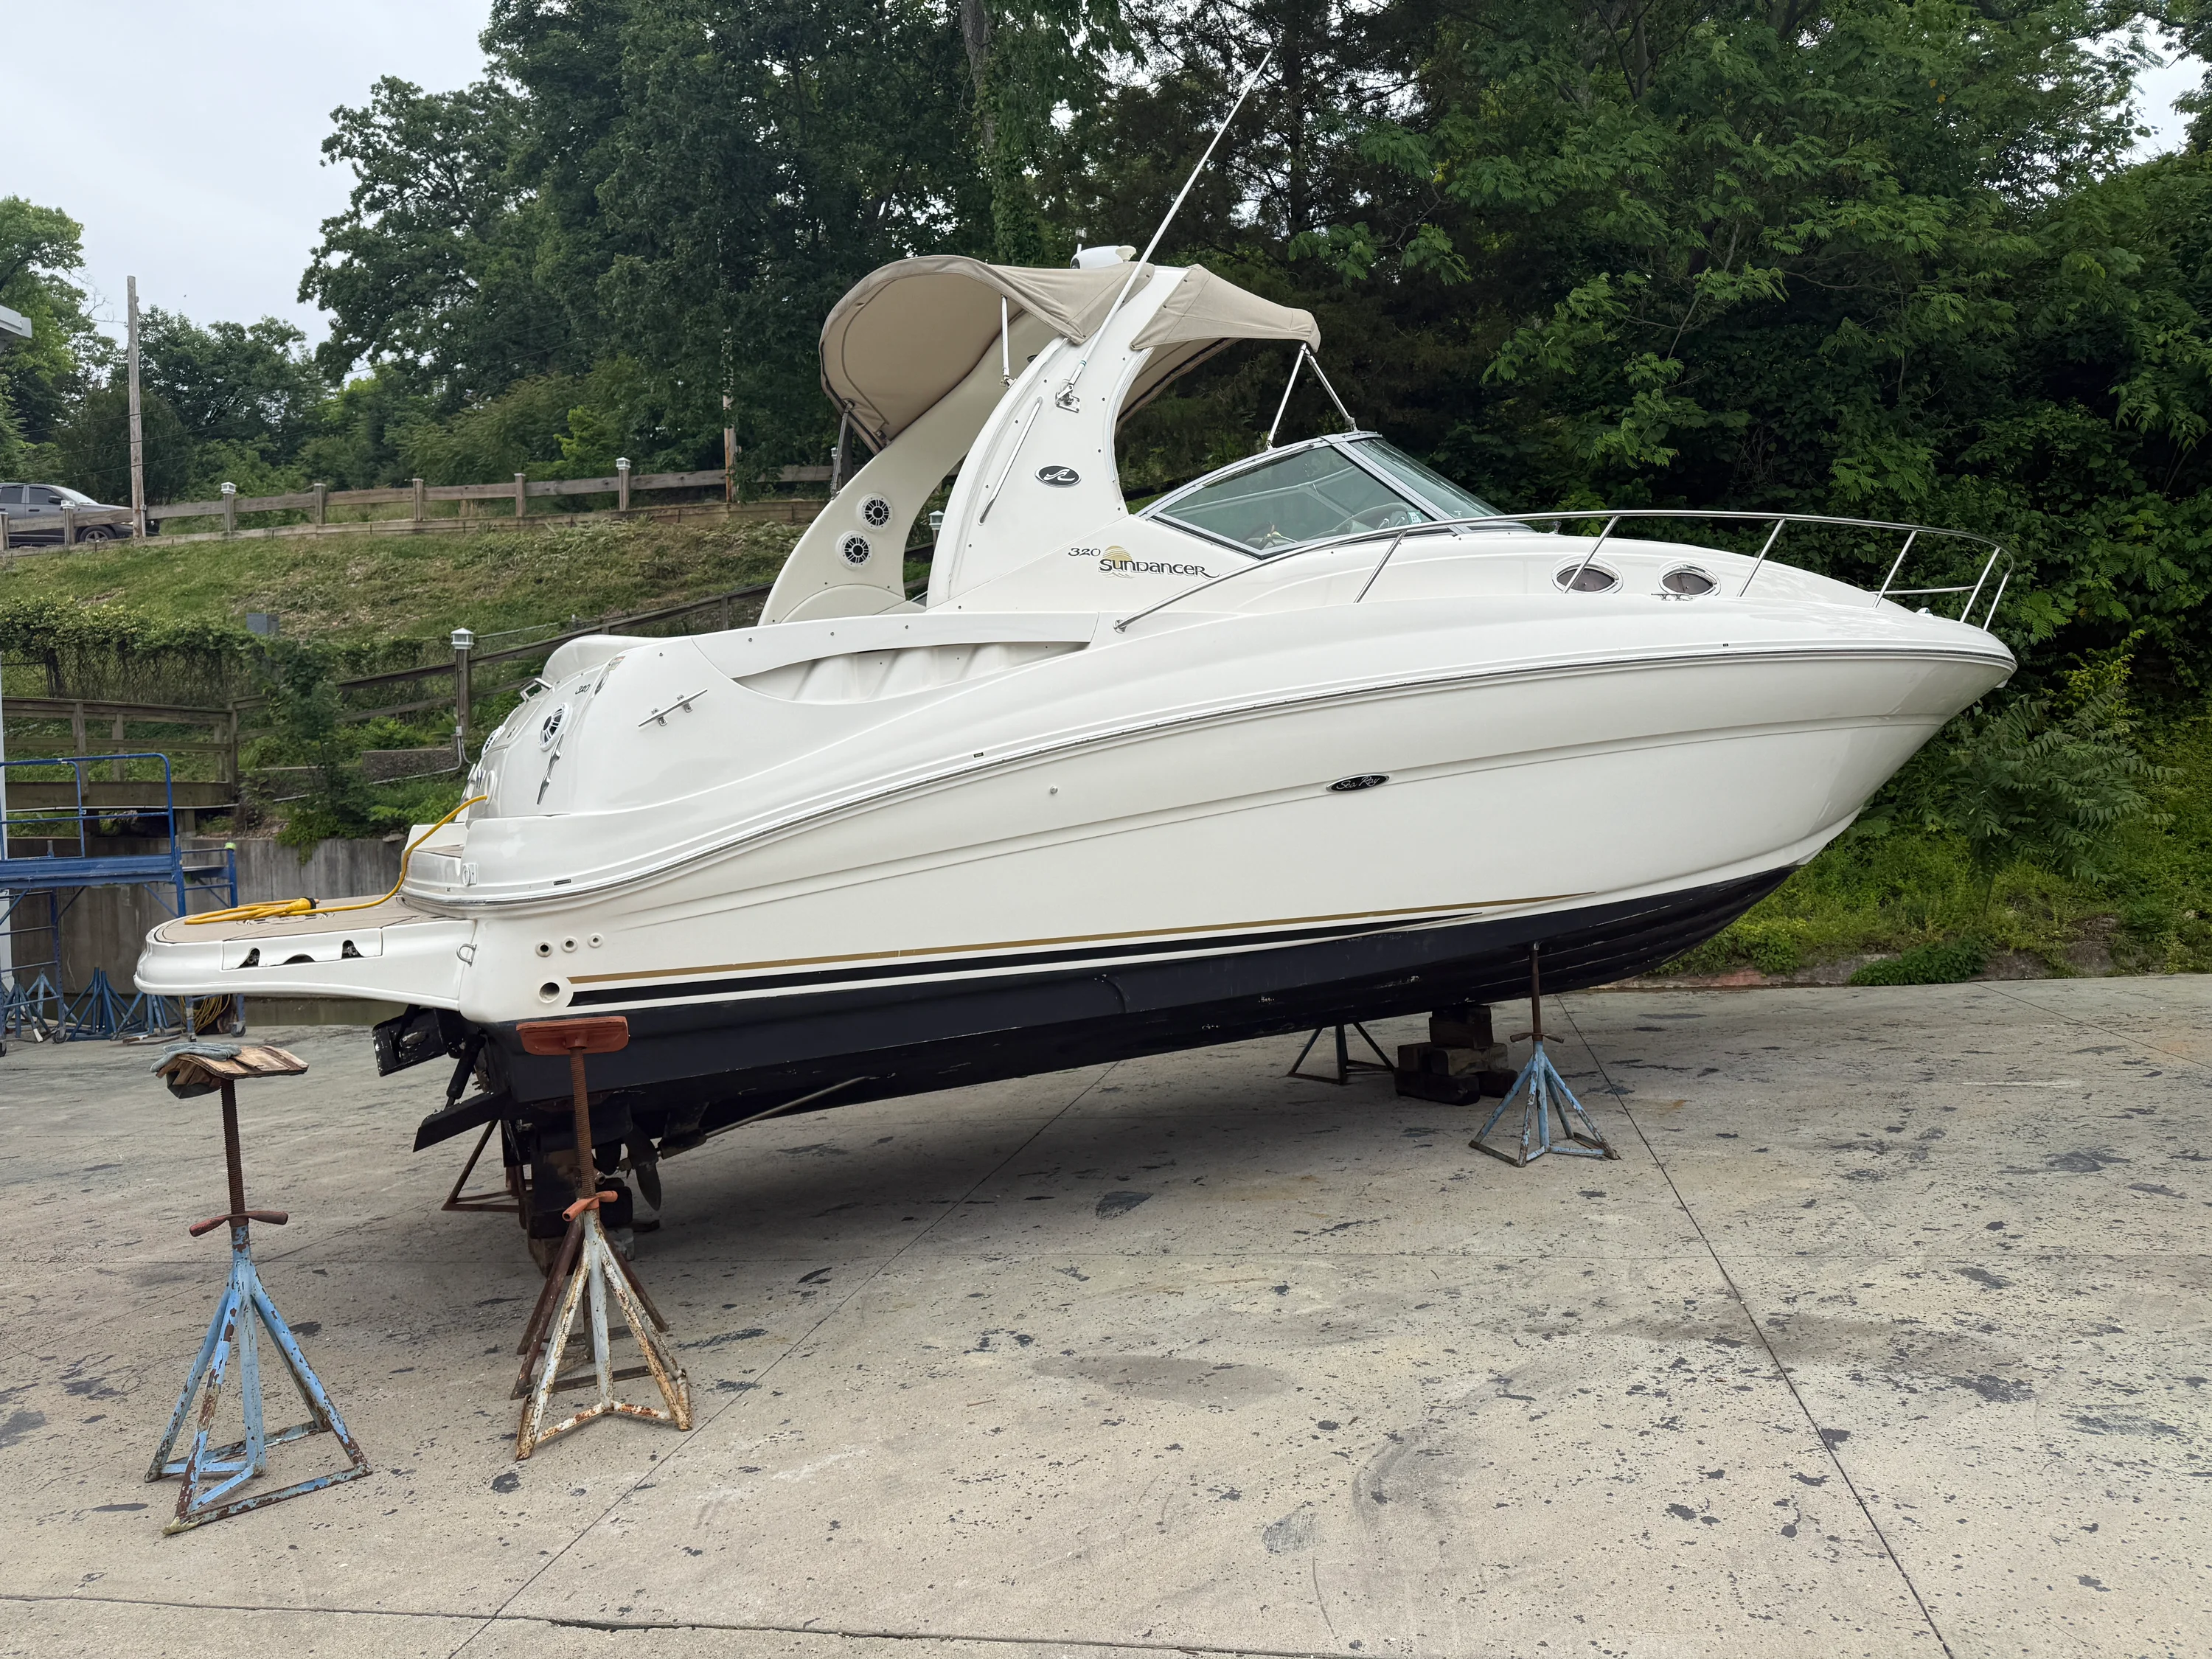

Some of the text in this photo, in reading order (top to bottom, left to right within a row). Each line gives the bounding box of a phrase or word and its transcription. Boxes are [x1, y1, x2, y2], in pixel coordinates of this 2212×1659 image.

[1068, 547, 1101, 557] 320
[1336, 776, 1380, 790] Sea Ray
